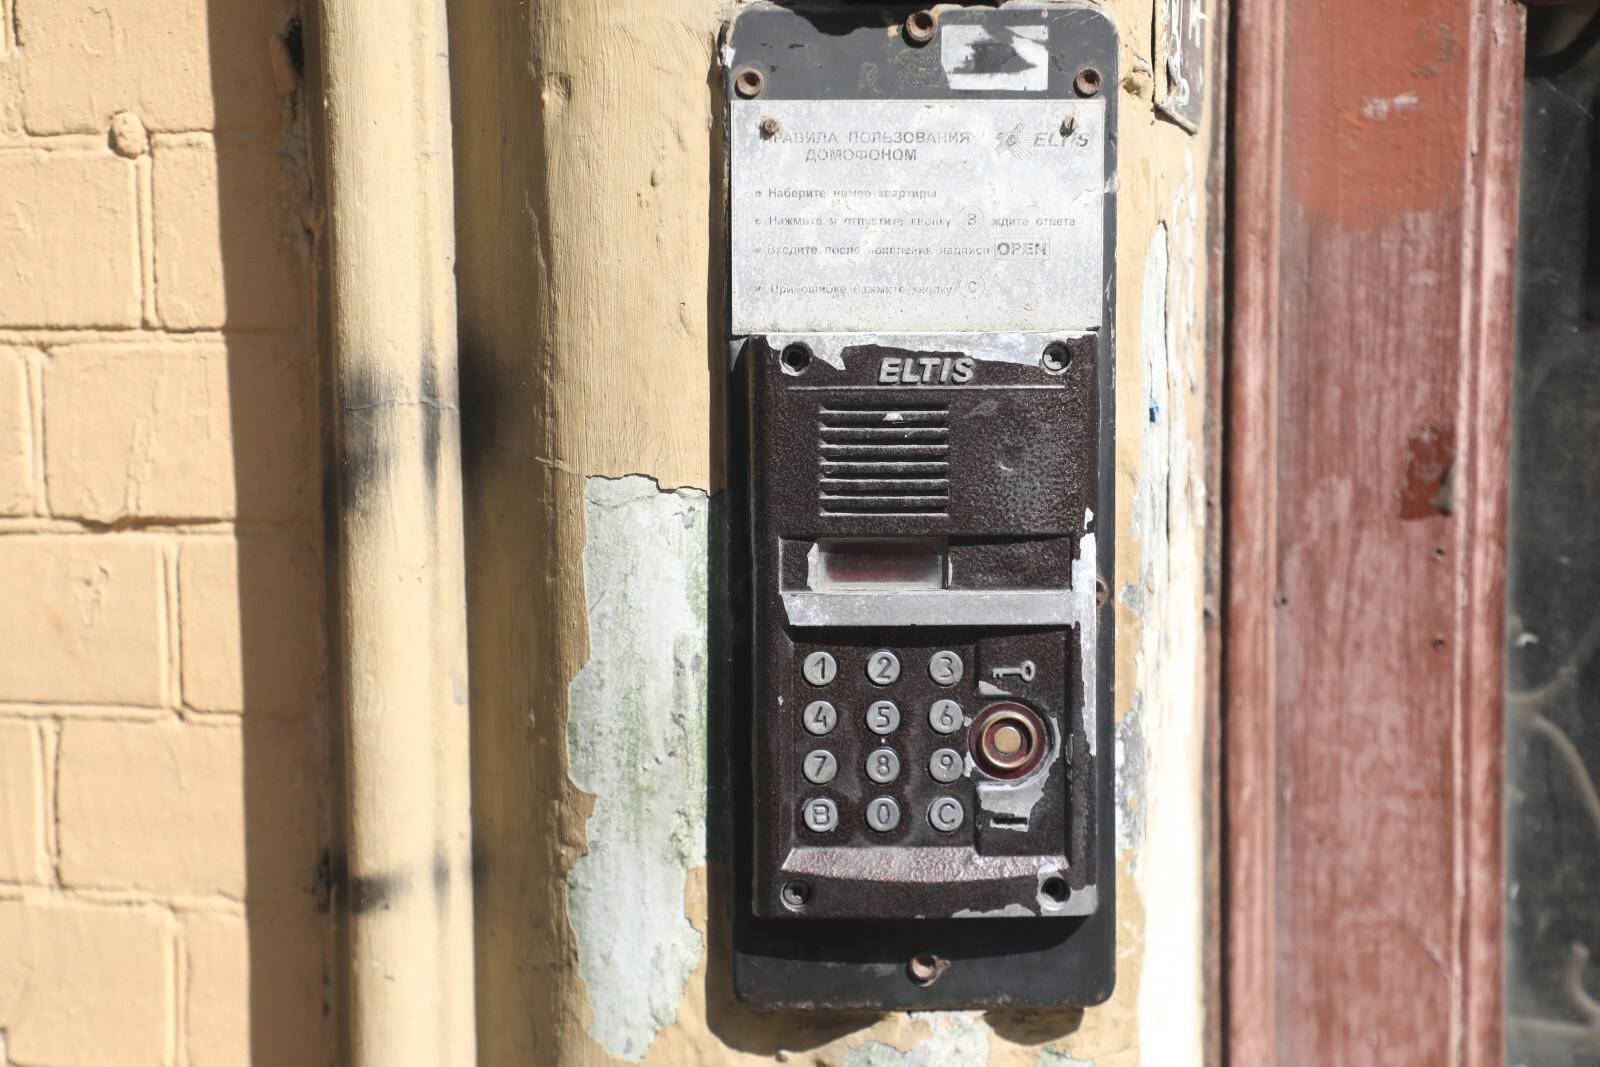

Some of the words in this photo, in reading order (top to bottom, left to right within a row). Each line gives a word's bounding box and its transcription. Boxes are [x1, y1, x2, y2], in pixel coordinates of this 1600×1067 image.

[763, 131, 838, 144] РАВИЛА
[849, 131, 970, 144] ПОЛЬЗОВАНИЯ
[805, 148, 917, 162] ДОМОФОНОМ
[768, 188, 826, 201] Наберите
[996, 242, 1047, 257] OPEN
[877, 357, 975, 384] ELTIS
[814, 657, 825, 680] 1
[877, 657, 891, 680] 2
[939, 657, 953, 680] 3
[813, 707, 828, 730] 4
[876, 706, 890, 728] 5
[940, 705, 952, 727] 6
[813, 756, 827, 778] 7
[877, 755, 890, 776] 8
[940, 754, 953, 776] 9
[813, 803, 830, 825] B
[878, 804, 890, 825] 0
[938, 803, 955, 824] C
